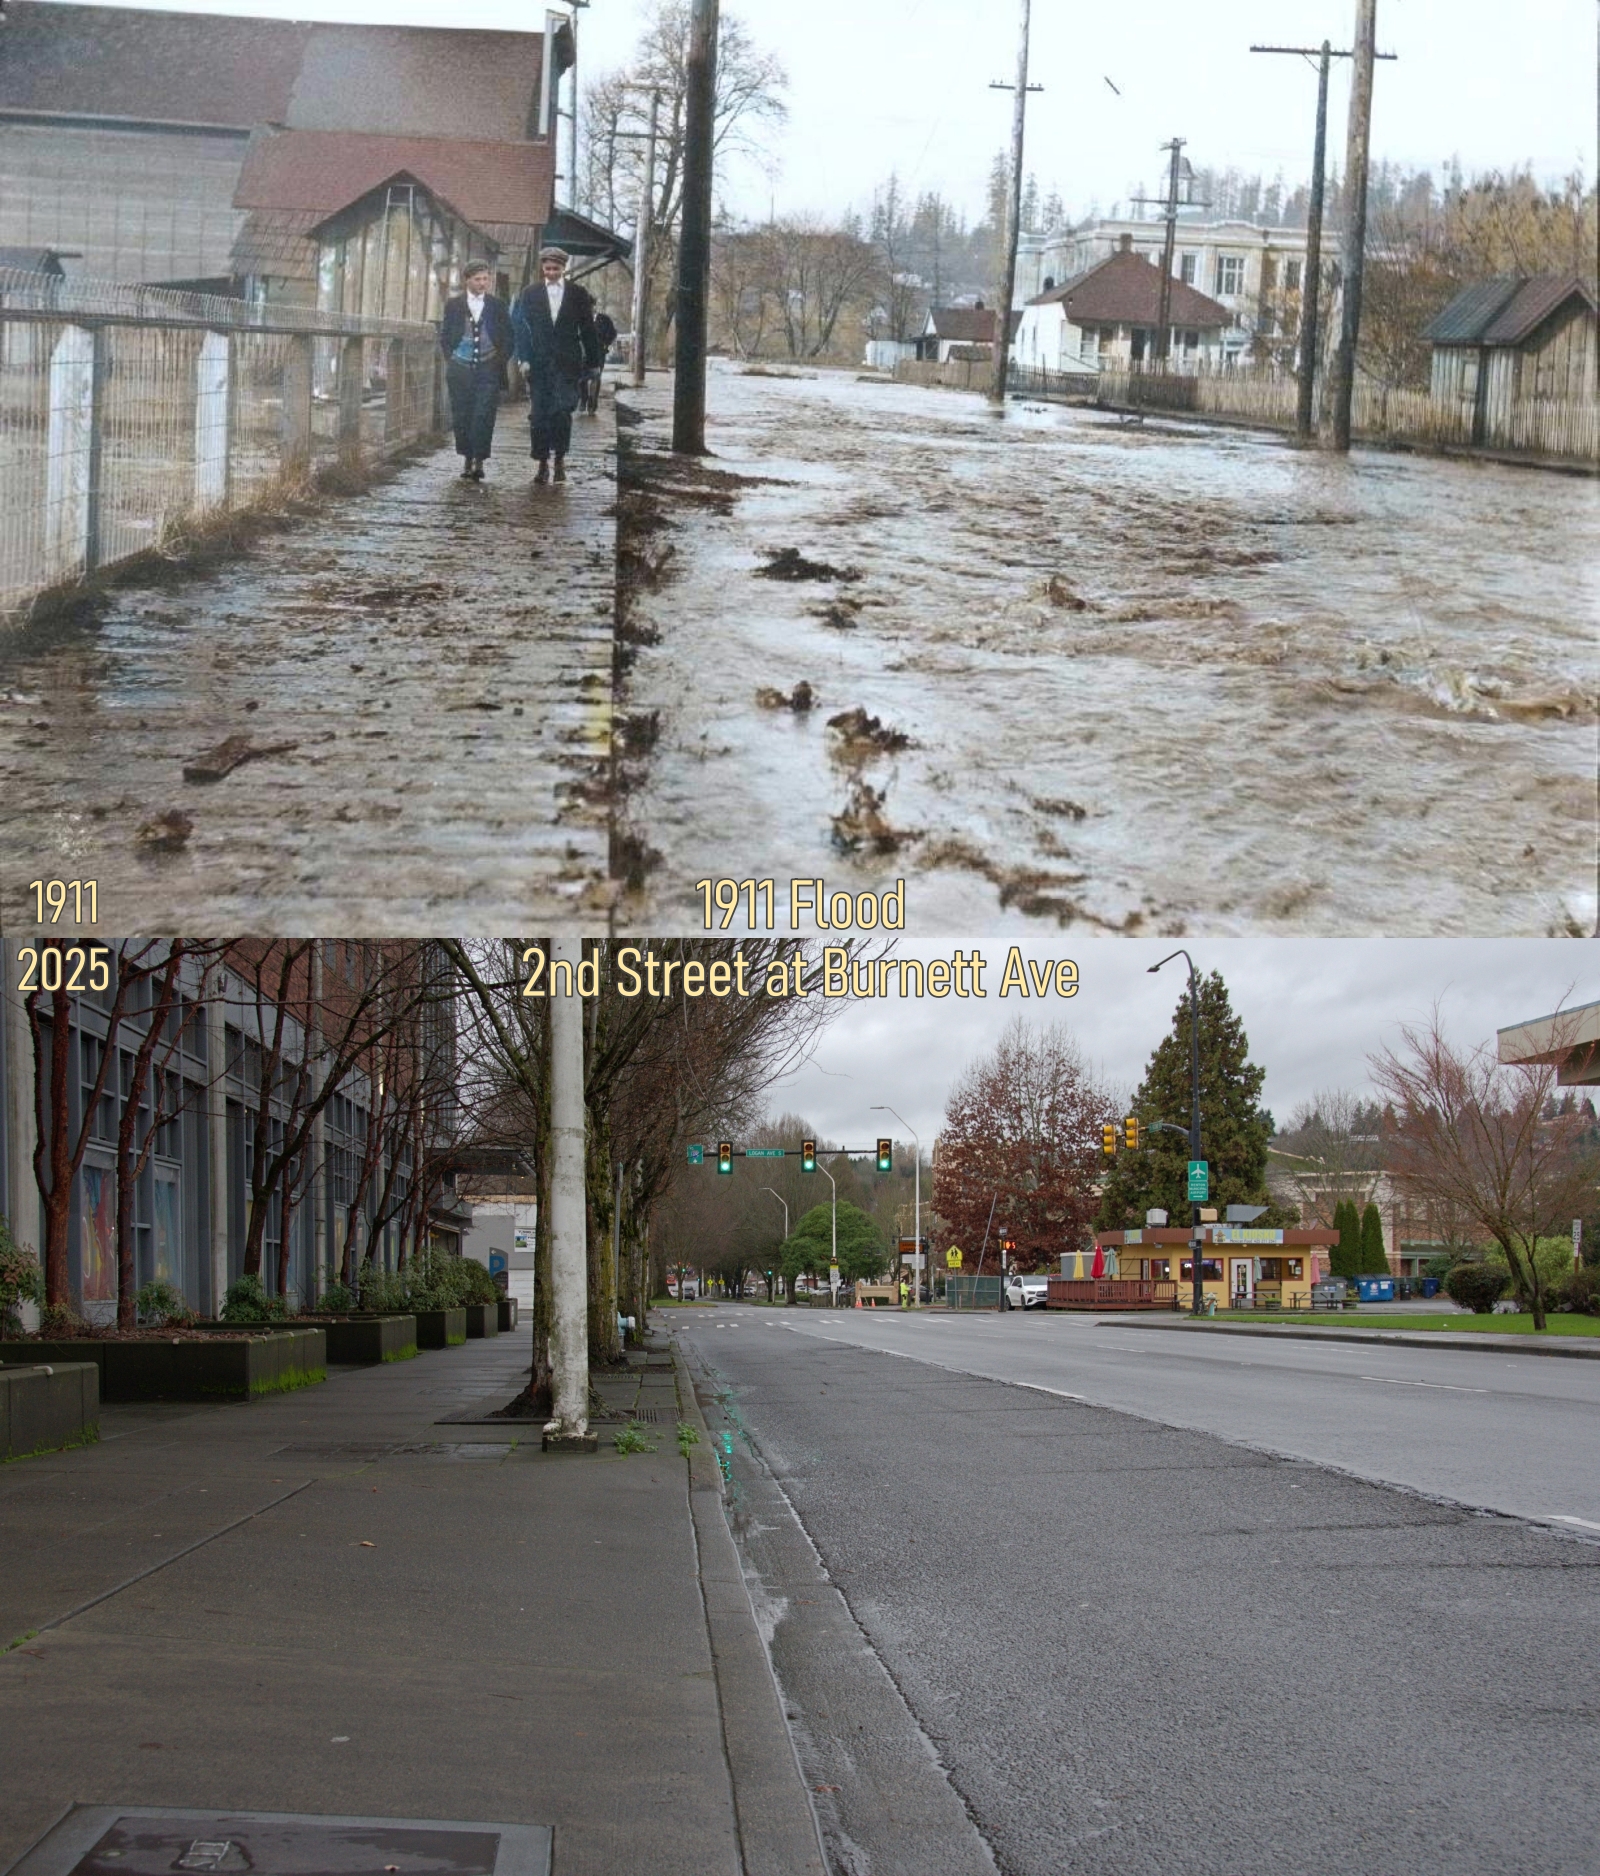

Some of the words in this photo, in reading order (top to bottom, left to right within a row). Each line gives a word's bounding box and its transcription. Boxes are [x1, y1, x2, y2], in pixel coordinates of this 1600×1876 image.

[1232, 1230, 1240, 1239] EL
[1243, 1230, 1276, 1239] KIOSKO
[489, 1255, 505, 1278] P
